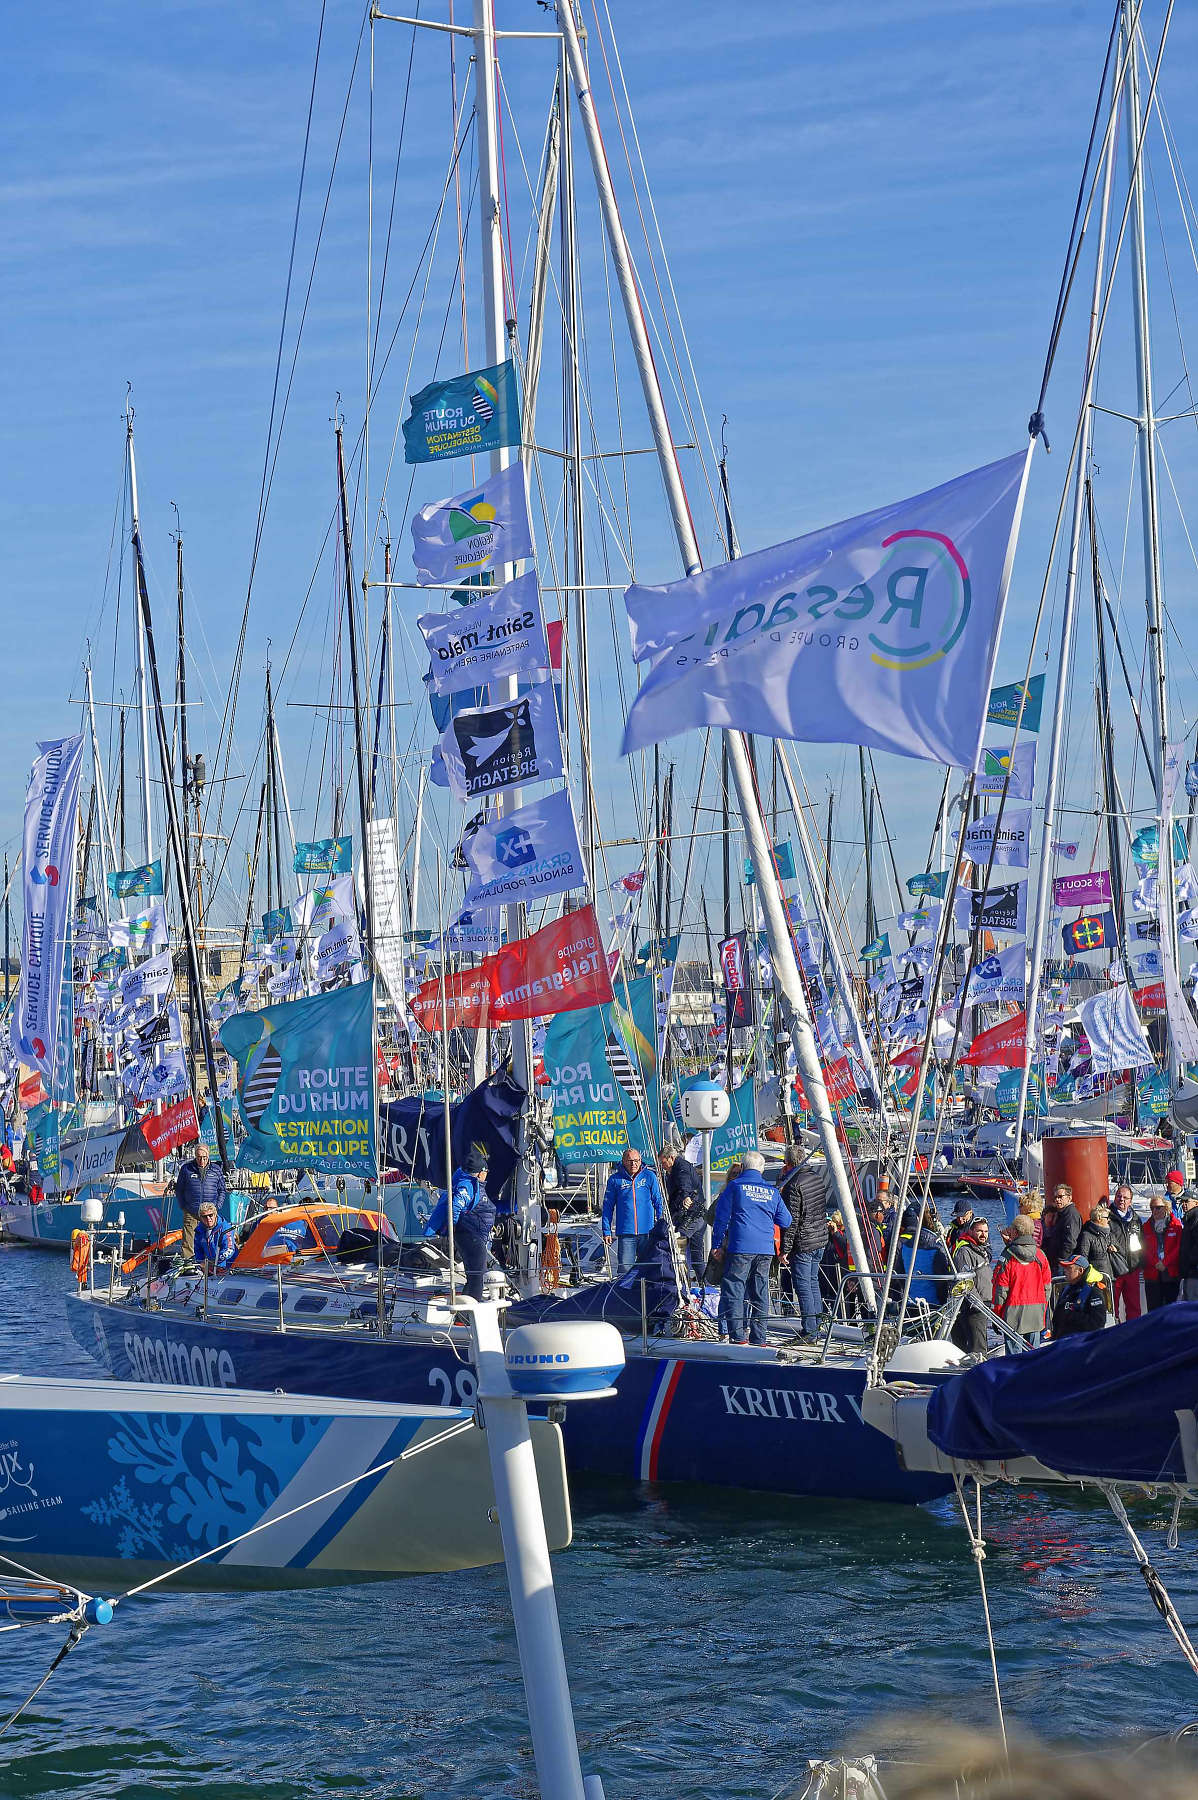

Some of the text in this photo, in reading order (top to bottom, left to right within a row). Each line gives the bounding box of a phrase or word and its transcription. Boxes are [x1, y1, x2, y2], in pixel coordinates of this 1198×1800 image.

[35, 743, 63, 858] SERVICE CIVIQU
[25, 911, 45, 1031] SERVICE CIVIQUE
[298, 1066, 368, 1089] ROUTE
[278, 1090, 368, 1114] DU RHUM
[711, 1098, 719, 1117] E
[124, 1331, 237, 1388] socomore
[719, 1385, 845, 1423] KRITER
[7, 1495, 63, 1516] SAILING TEAM
